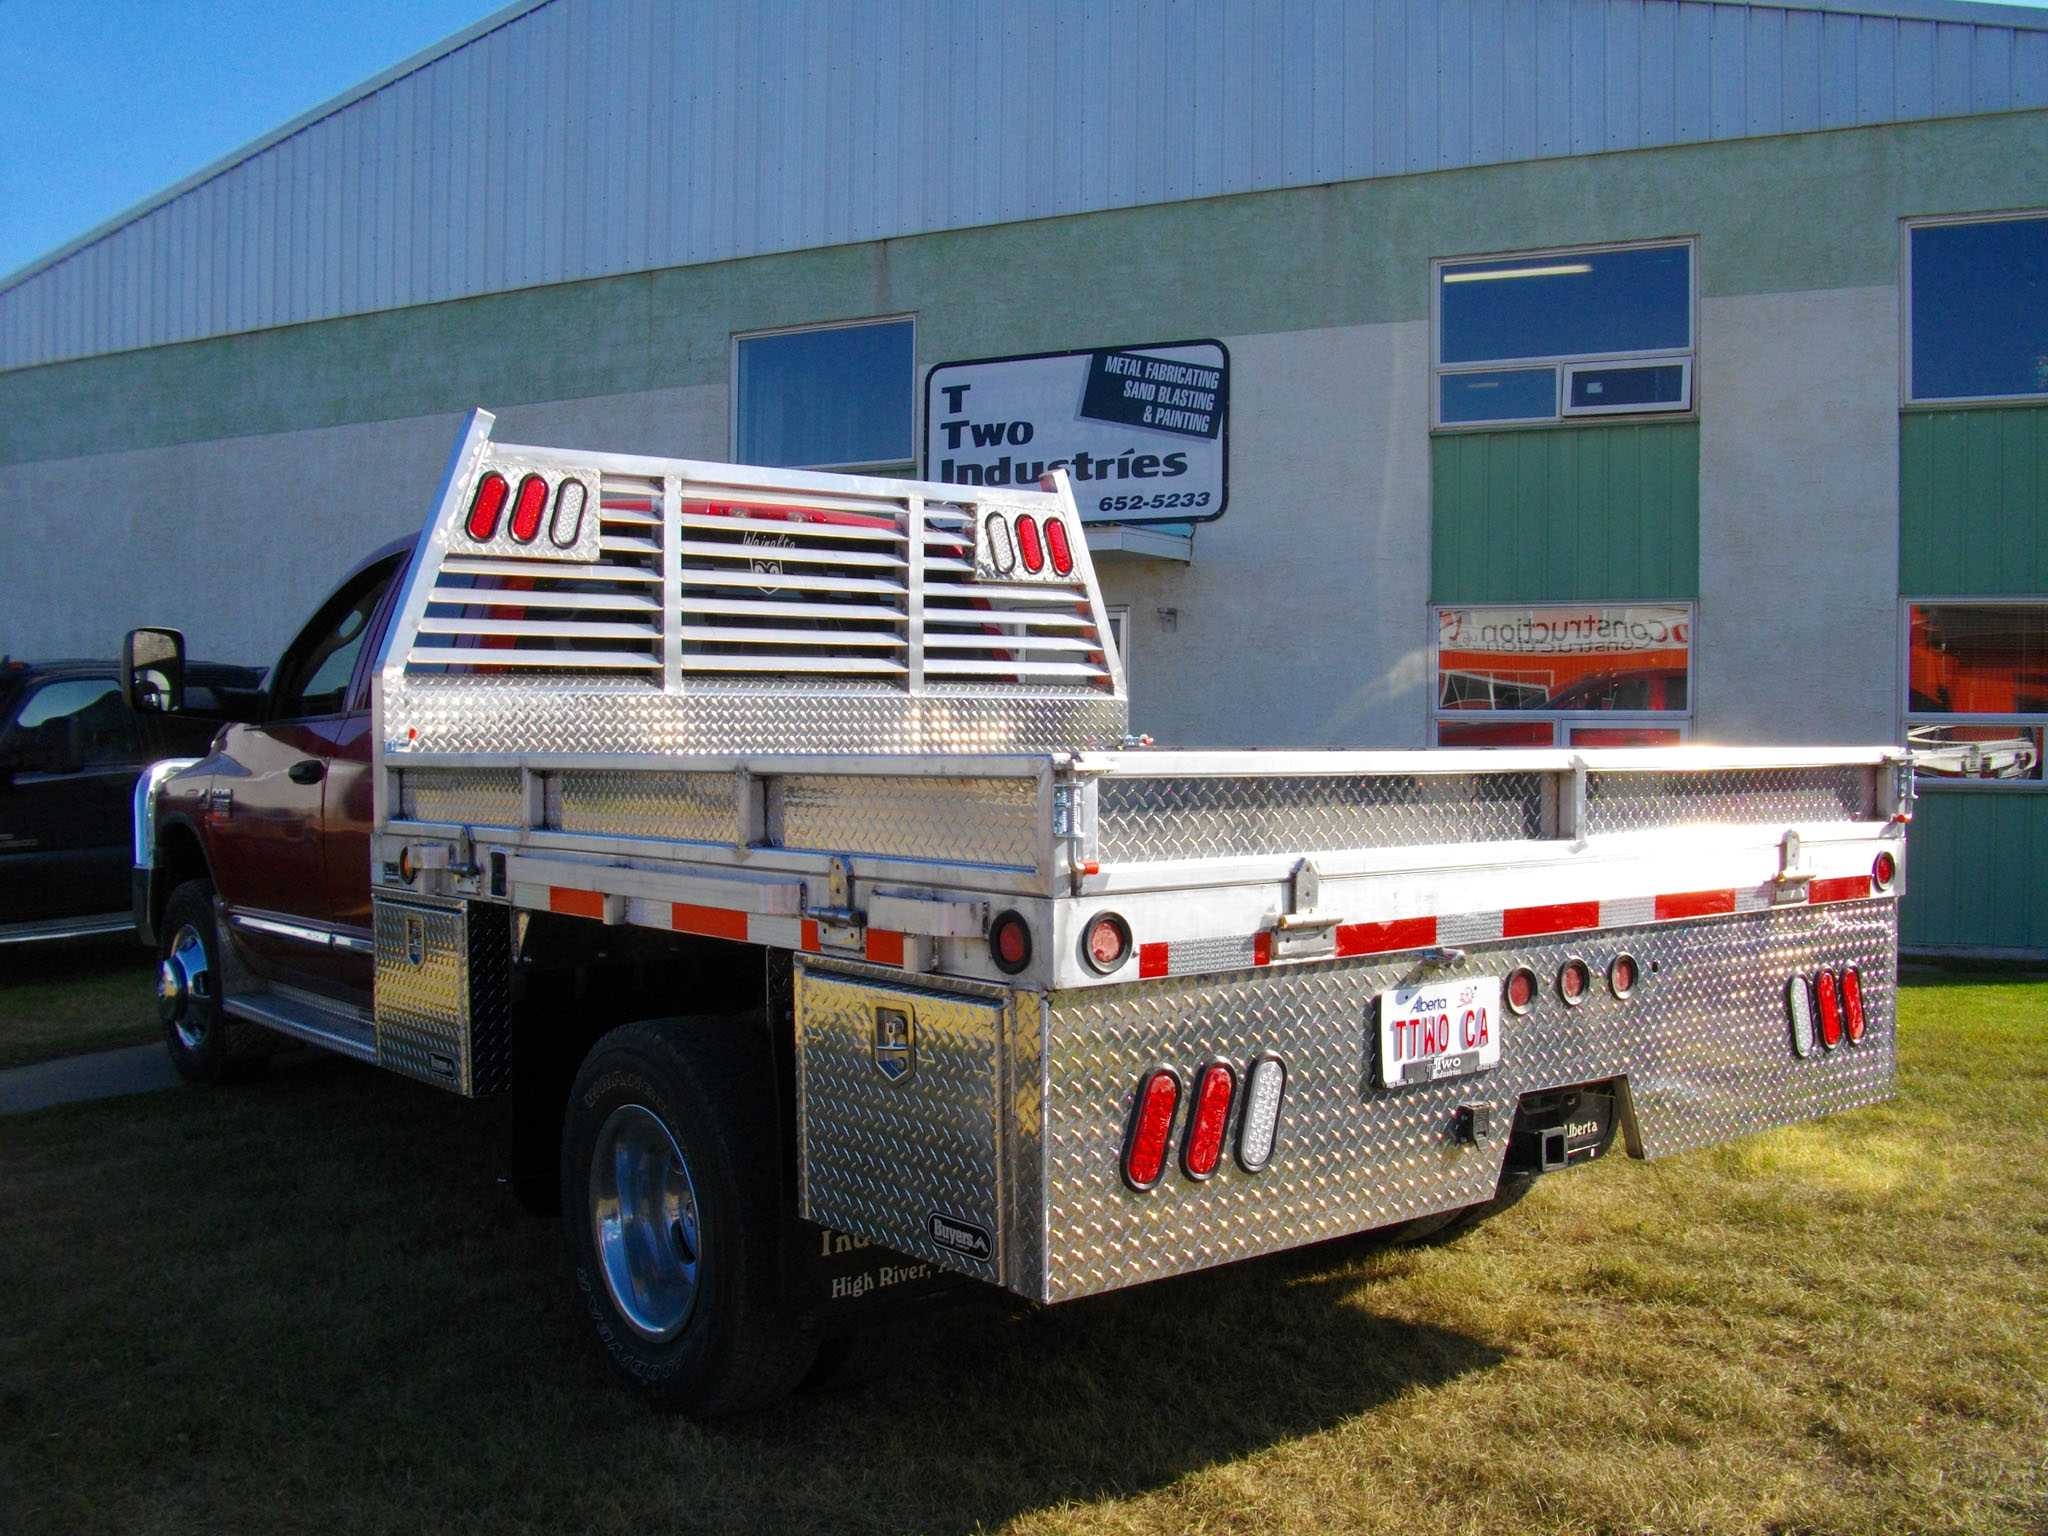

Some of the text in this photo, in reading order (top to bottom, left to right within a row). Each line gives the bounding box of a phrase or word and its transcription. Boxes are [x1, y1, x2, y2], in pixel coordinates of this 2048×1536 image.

[1104, 355, 1220, 390] METAL FABRICATING
[941, 384, 971, 414] T
[1123, 379, 1215, 411] SAND BLASTING
[1143, 405, 1211, 433] & PAINTING
[940, 420, 1034, 450] Two
[941, 448, 1188, 486] Industries
[1099, 491, 1211, 513] 652-5233
[1410, 996, 1447, 1015] Alberta
[1394, 1007, 1489, 1059] TTWO CA
[1433, 1057, 1461, 1071] Two
[933, 1218, 975, 1246] Buyers
[831, 1263, 932, 1298] High River,
